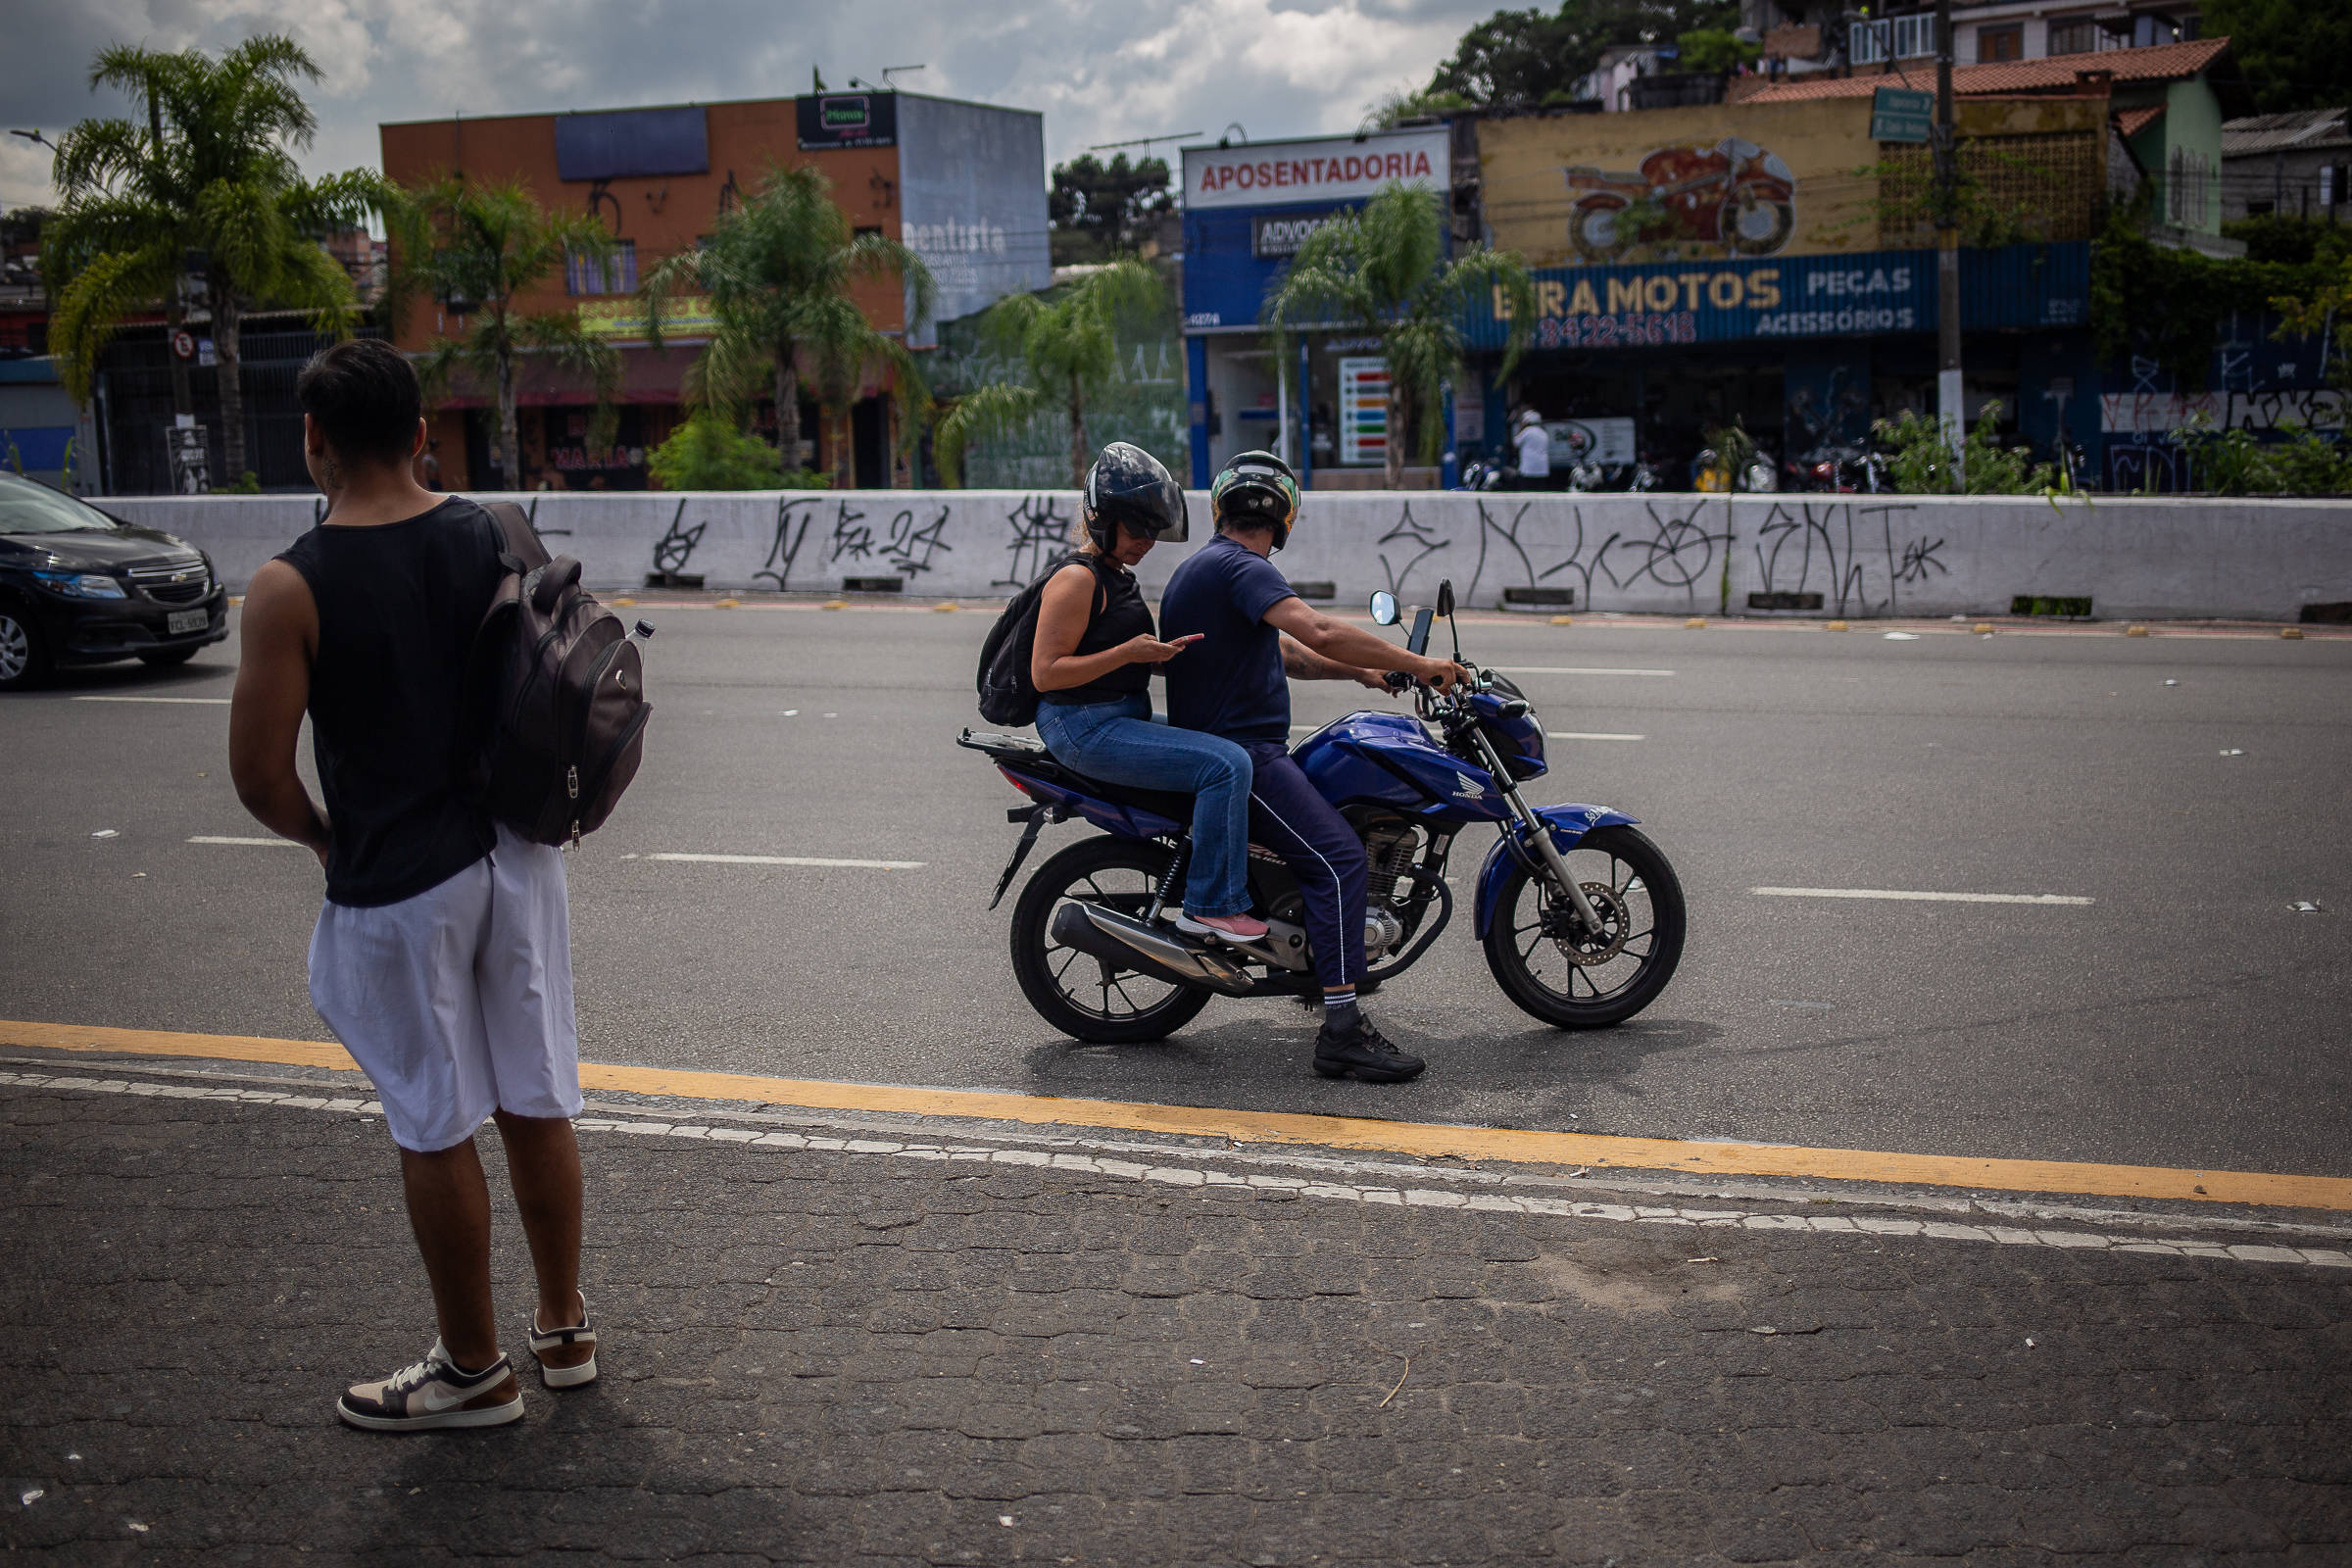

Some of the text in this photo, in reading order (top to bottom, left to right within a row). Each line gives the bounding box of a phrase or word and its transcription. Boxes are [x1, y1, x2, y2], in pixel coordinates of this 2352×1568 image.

[1201, 151, 1432, 191] APOSENTADORIA
[1606, 269, 1782, 314] MOTOS
[1807, 268, 1911, 297] PEÇAS
[1538, 312, 1697, 348] 3422-5618
[1451, 791, 1483, 800] HONDA
